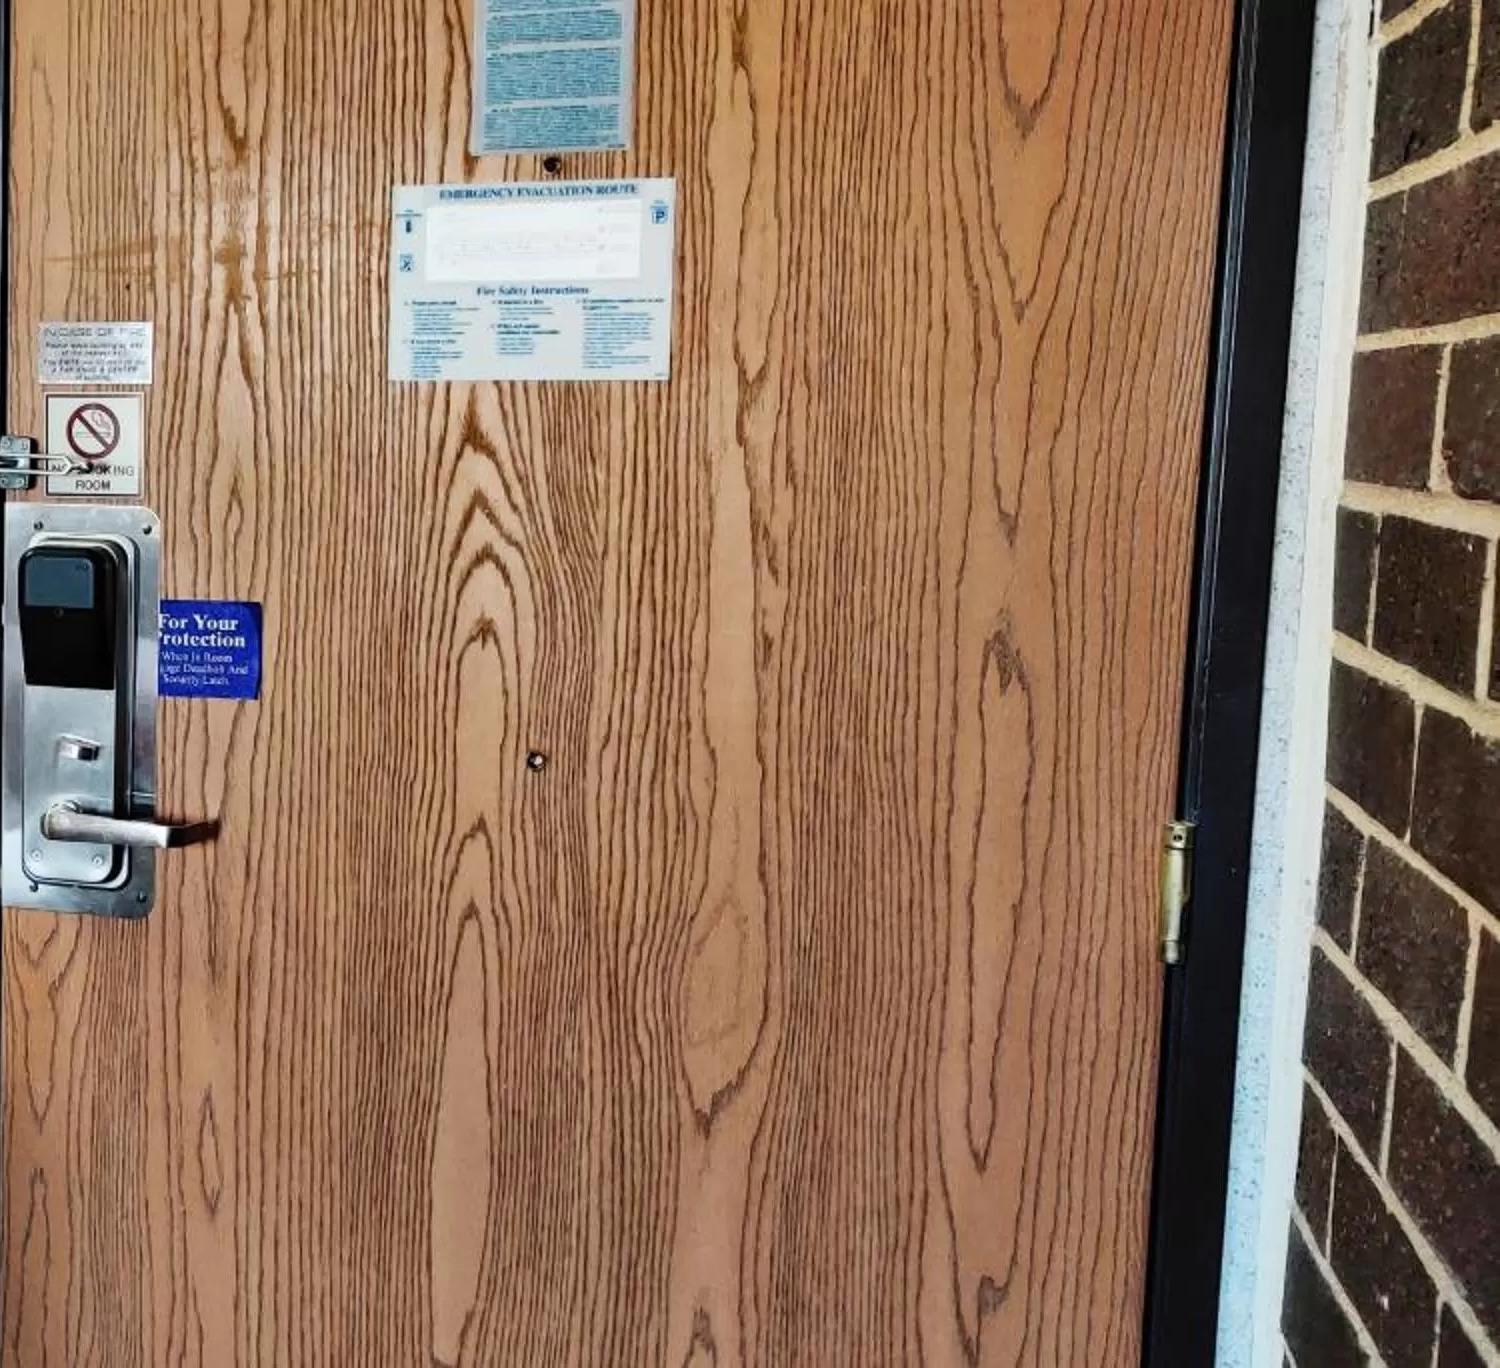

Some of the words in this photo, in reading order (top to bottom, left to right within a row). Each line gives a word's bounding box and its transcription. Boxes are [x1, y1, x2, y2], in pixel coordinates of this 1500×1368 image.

[439, 188, 514, 200] EMERGENCY
[517, 186, 593, 198] EVACUATION
[596, 184, 638, 195] ROUTE
[476, 286, 496, 296] Fire
[498, 286, 528, 297] Safety
[531, 285, 589, 295] Instructions
[75, 479, 111, 491] ROOM
[158, 613, 188, 630] For
[193, 613, 239, 631] Your
